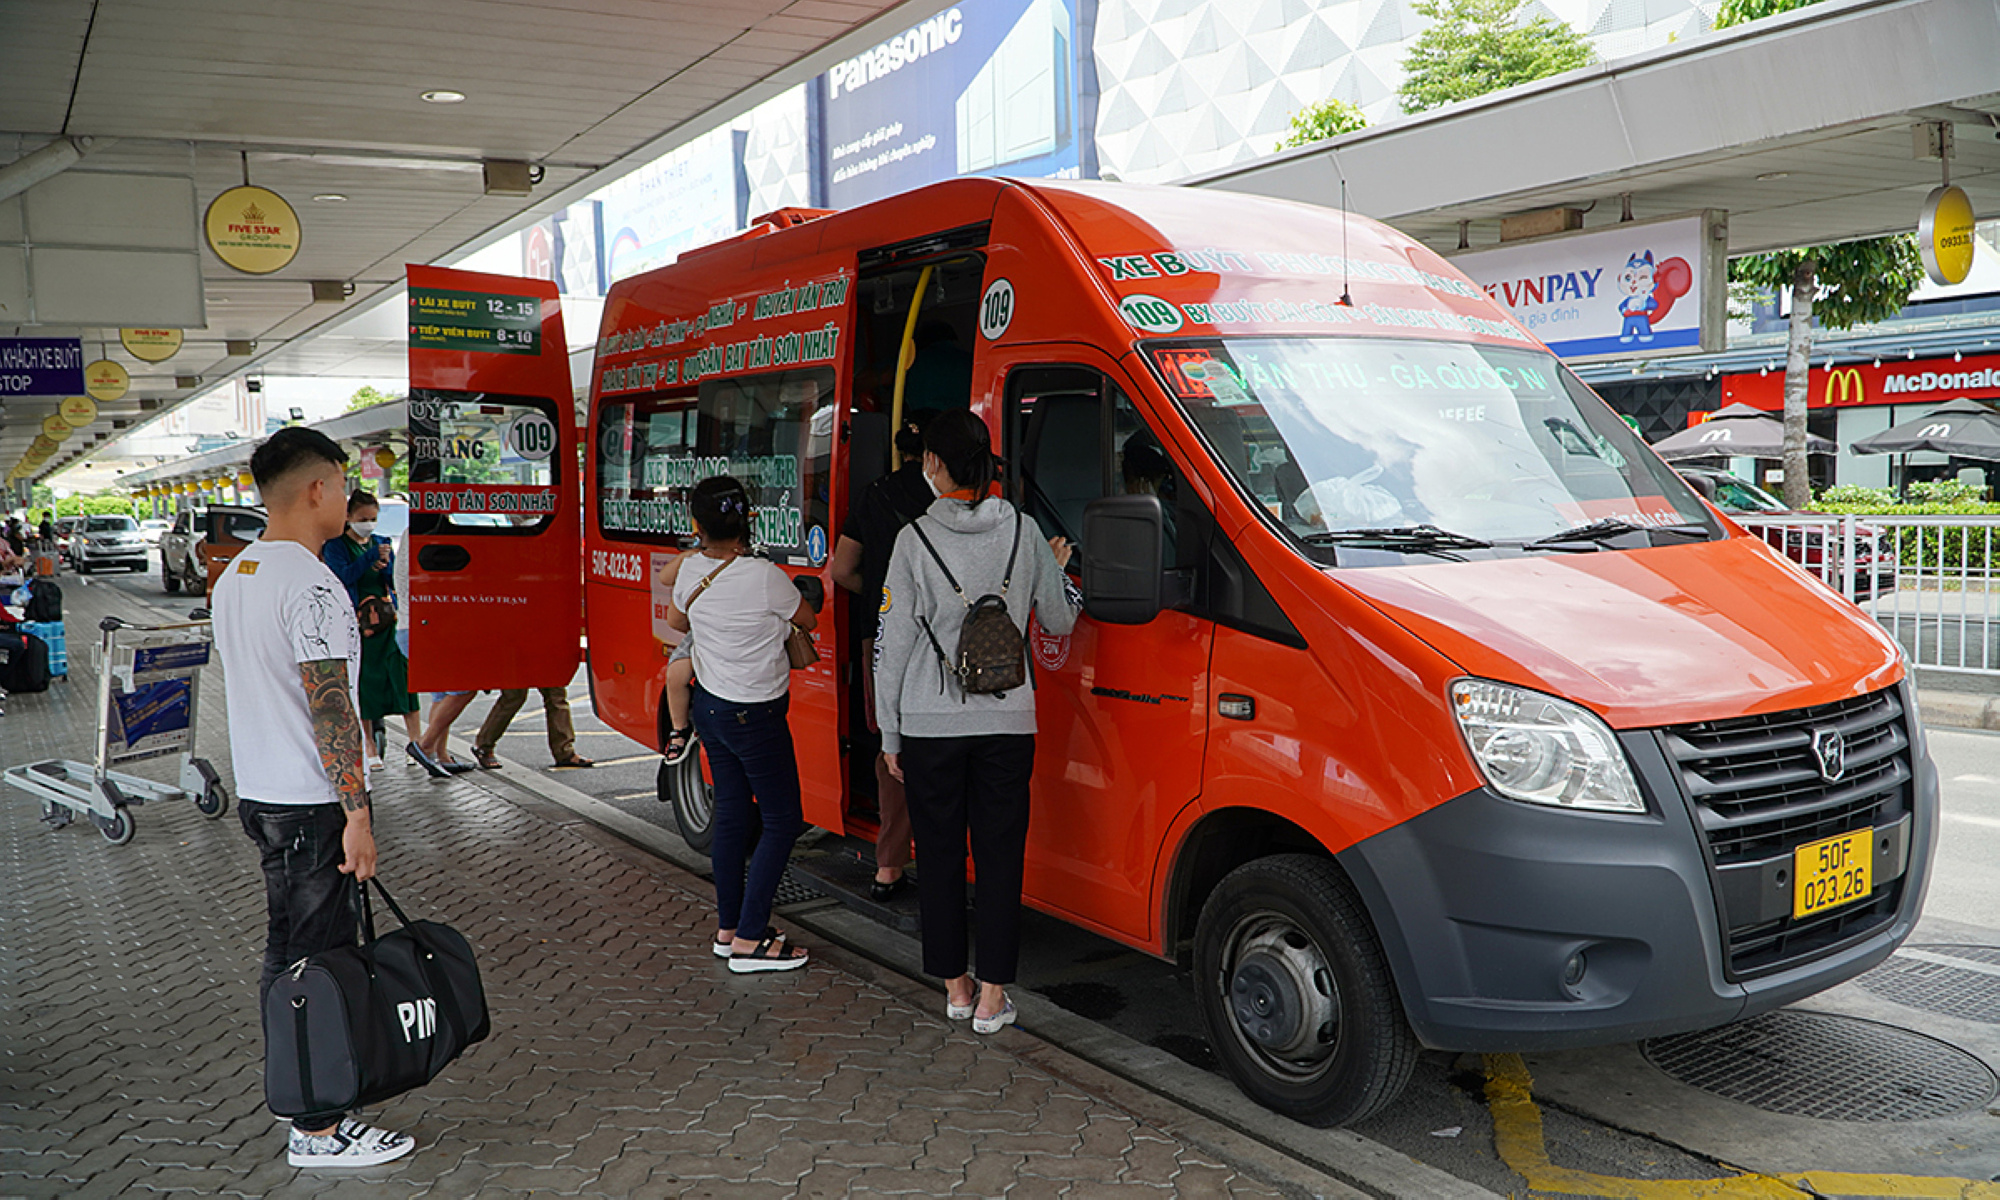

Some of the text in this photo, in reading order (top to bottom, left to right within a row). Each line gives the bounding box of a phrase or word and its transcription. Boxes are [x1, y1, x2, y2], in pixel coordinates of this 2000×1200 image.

[829, 8, 963, 100] Panasonic
[228, 224, 281, 235] FIVE STAR
[239, 234, 271, 242] GROUP
[1097, 255, 1163, 281] XE
[1149, 247, 1253, 276] BUÝT
[753, 279, 798, 321] NGUYỄN
[1501, 267, 1604, 308] VNPAY
[486, 299, 505, 313] 12
[517, 301, 535, 315] 15
[984, 288, 1011, 330] 109
[1123, 301, 1178, 327] 109
[1180, 302, 1218, 325] BX
[1208, 297, 1269, 325] BUÝT
[1266, 297, 1305, 323] SÀI
[38, 348, 54, 369] XE
[55, 344, 80, 369] BUÝT
[697, 342, 724, 377] SÂN
[724, 341, 749, 372] BAY
[748, 333, 773, 370] TÂN
[773, 331, 801, 366] SƠN
[801, 321, 840, 363] NHẤT
[1220, 353, 1300, 391] VĂN
[1299, 361, 1370, 395] THỤ
[1389, 363, 1439, 391] GA
[1435, 358, 1520, 391] QUỐC
[414, 436, 485, 460] TRANG
[514, 421, 551, 453] 109
[424, 491, 453, 511] BAY
[456, 488, 485, 511] TÂN
[489, 492, 518, 511] SƠN
[520, 488, 556, 511] NHẤT
[755, 489, 802, 548] NHẤT
[592, 549, 643, 582] 50F-023.26
[1819, 838, 1852, 873] 50F
[1804, 866, 1865, 910] 023.26
